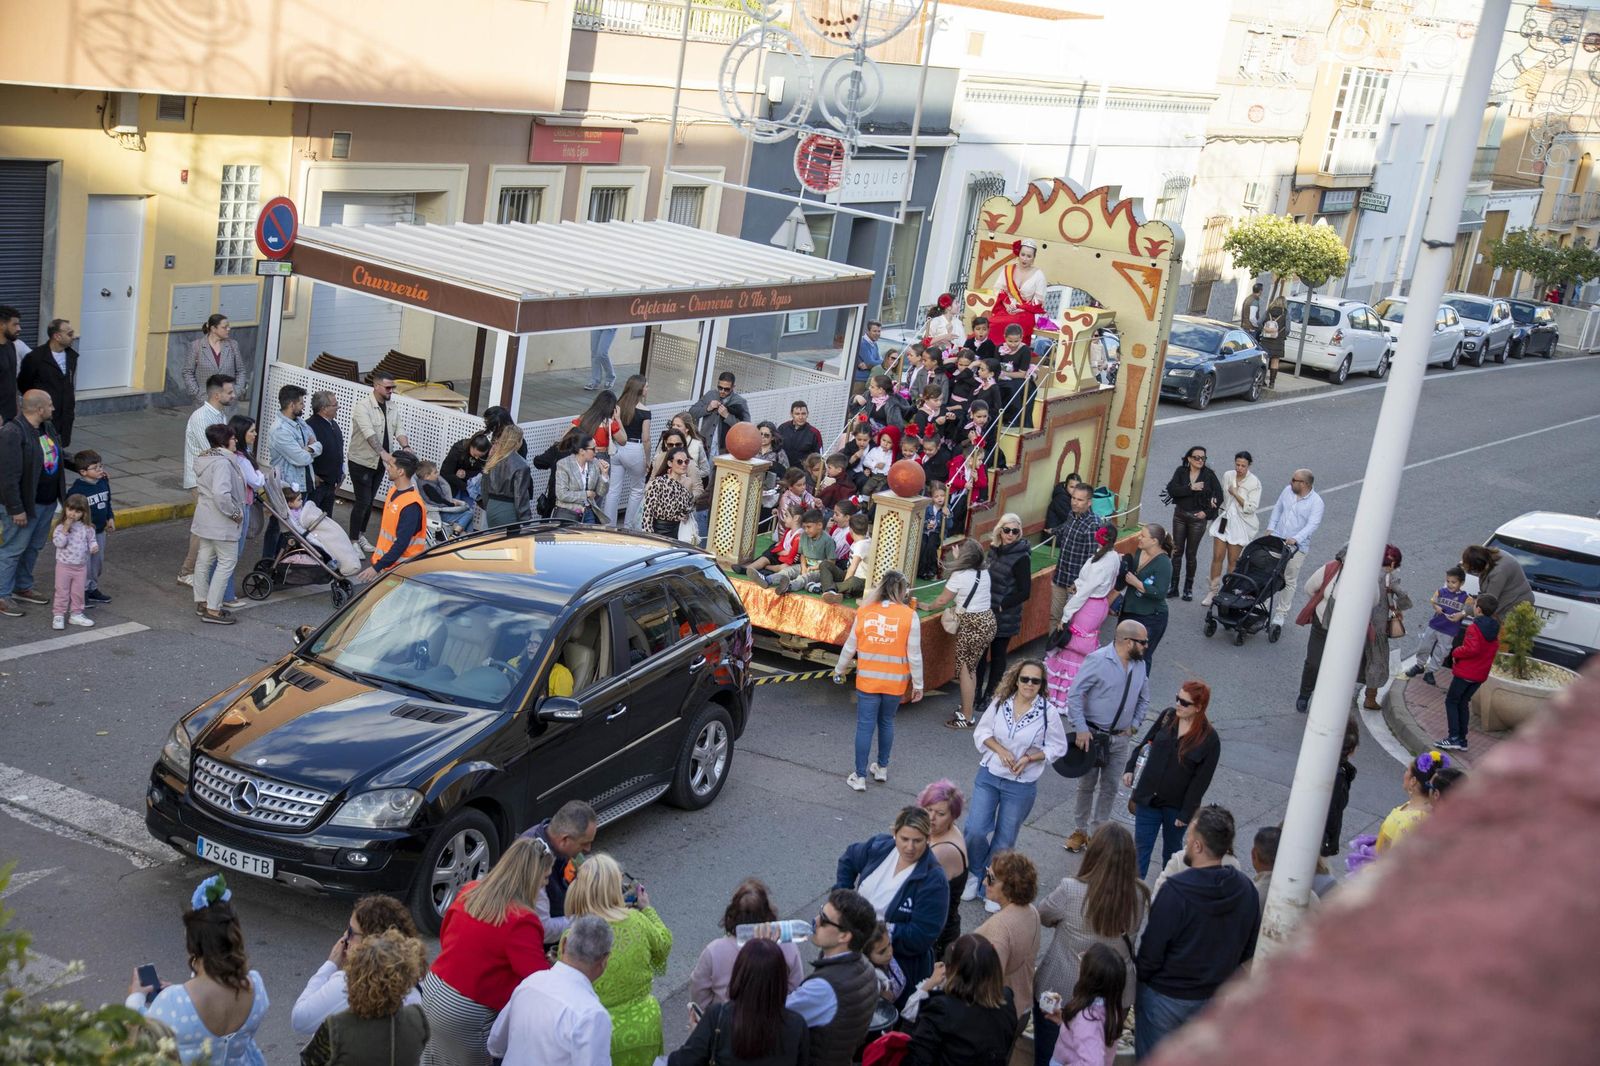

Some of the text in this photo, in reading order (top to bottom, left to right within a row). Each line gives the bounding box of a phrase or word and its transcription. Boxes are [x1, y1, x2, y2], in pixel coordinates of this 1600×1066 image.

[631, 297, 677, 320] Cafetería
[205, 842, 270, 875] 7546 FTB
